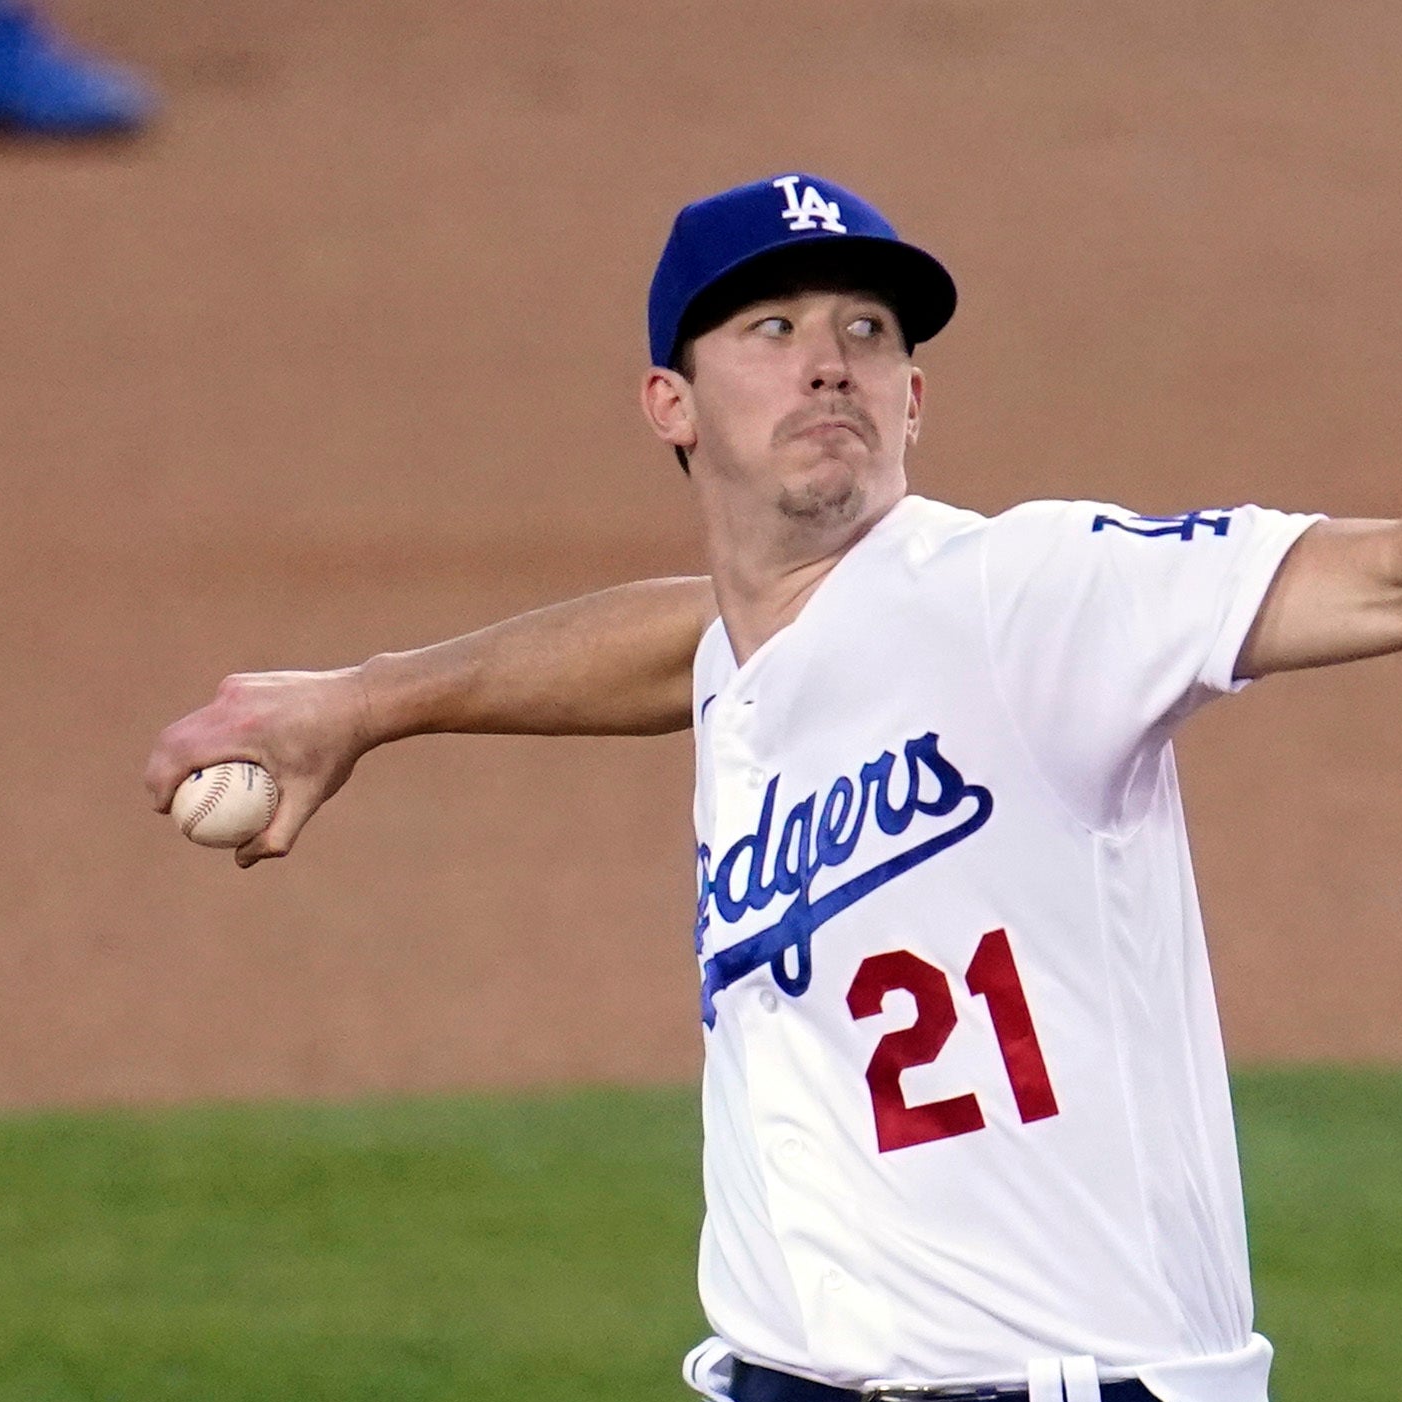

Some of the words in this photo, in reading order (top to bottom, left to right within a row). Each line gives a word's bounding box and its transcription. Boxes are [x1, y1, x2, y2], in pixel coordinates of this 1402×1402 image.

[773, 175, 847, 234] LA
[694, 731, 994, 1031] dgers
[846, 928, 1059, 1154] 21
